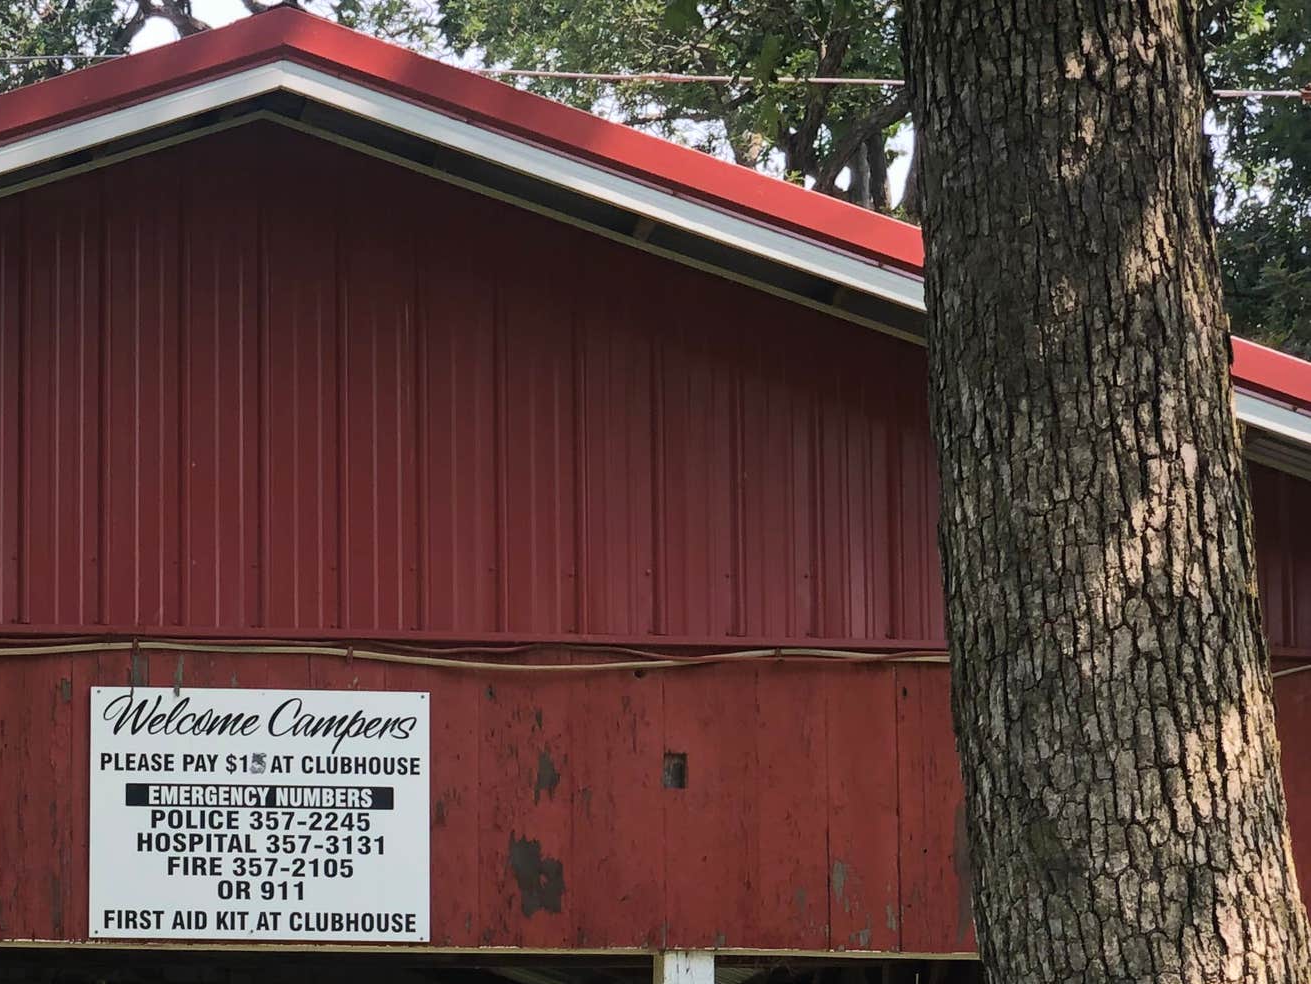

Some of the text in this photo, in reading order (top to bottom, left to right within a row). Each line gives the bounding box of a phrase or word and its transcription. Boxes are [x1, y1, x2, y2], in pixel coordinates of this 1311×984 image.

[103, 694, 417, 754] Welcome Campers
[100, 752, 175, 772] PLEASE
[182, 753, 219, 773] PAY
[270, 755, 294, 774] AT
[301, 755, 421, 776] CLUBHOUSE
[148, 785, 373, 808] EMERGENCY NUMBERS
[150, 809, 371, 831] POLICE 357-2245
[137, 832, 385, 855] HOSPITAL 357-3131
[167, 856, 354, 878] FIRE 357-2105
[217, 880, 305, 901] OR 911
[103, 909, 165, 930] FIRST
[171, 911, 208, 930] AID
[256, 911, 282, 931] AT
[289, 912, 417, 933] CLUBHOUSE
